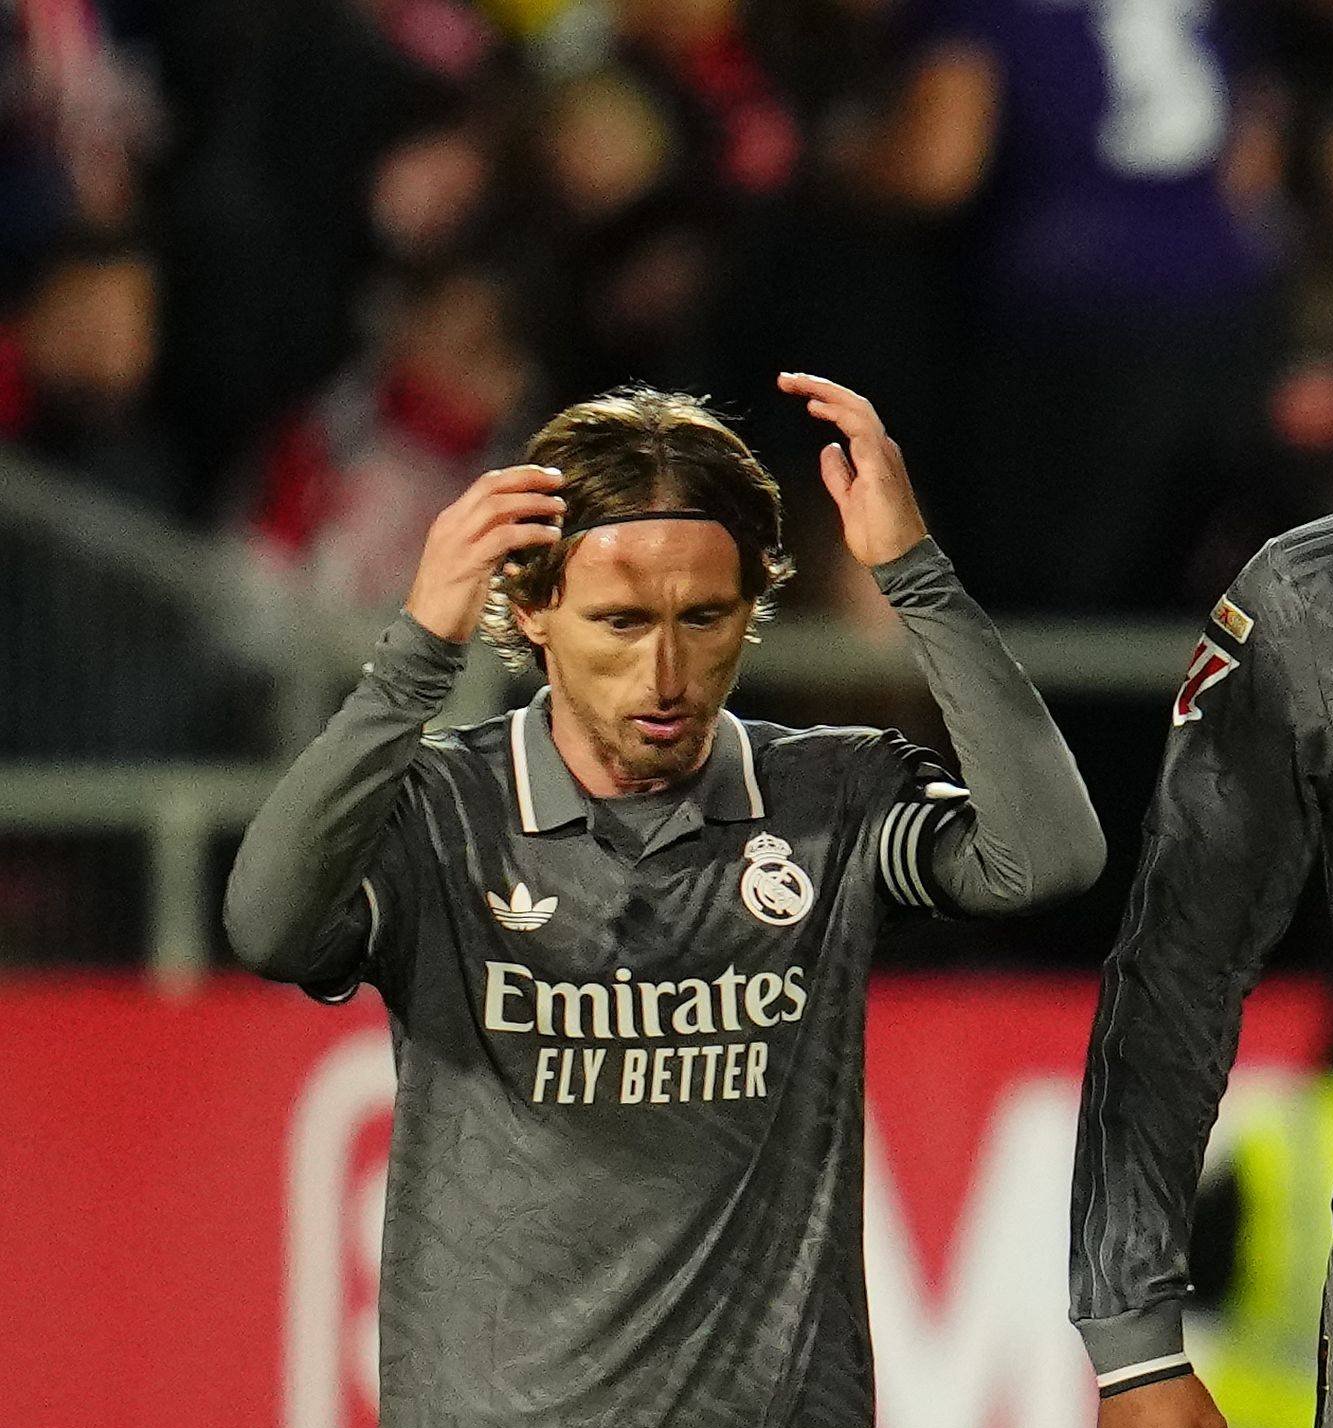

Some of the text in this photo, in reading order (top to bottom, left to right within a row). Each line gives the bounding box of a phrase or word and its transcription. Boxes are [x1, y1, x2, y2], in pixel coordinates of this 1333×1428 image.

[485, 961, 808, 1040] Emirates
[533, 1041, 769, 1105] FLY BETTER
